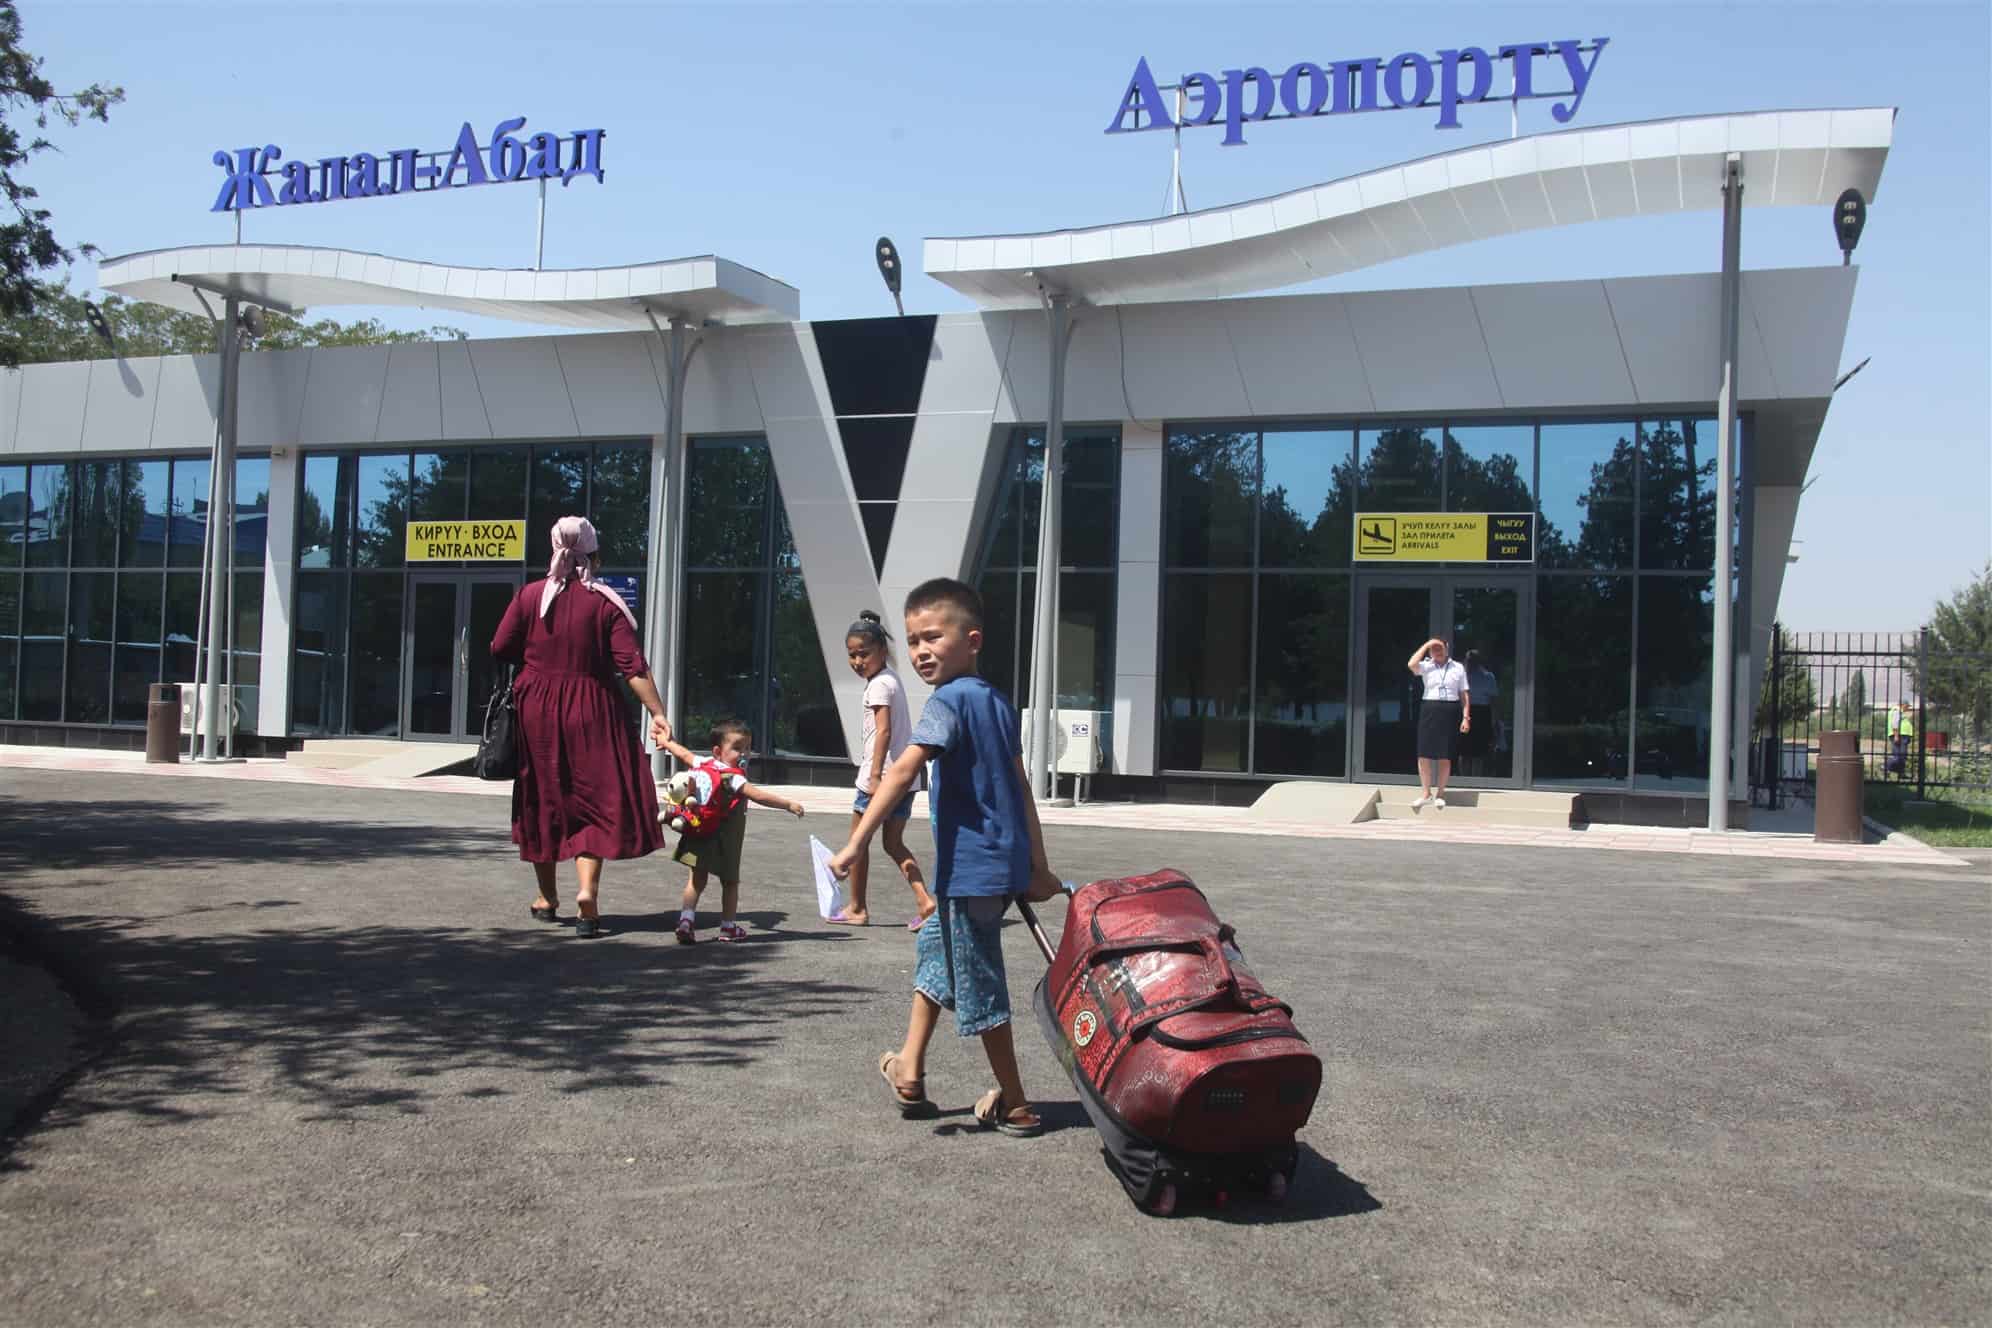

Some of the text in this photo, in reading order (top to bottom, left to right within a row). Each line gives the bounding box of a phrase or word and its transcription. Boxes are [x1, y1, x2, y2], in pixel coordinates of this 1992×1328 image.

[1104, 37, 1610, 146] Аэропорту
[210, 116, 606, 212] Жалал-Абад
[472, 524, 518, 541] ВХОД
[1401, 531, 1418, 540] ЗАЛ
[427, 542, 506, 558] ENTRANCE
[1401, 541, 1440, 550] ARRIVALS
[1501, 545, 1520, 555] EXIT
